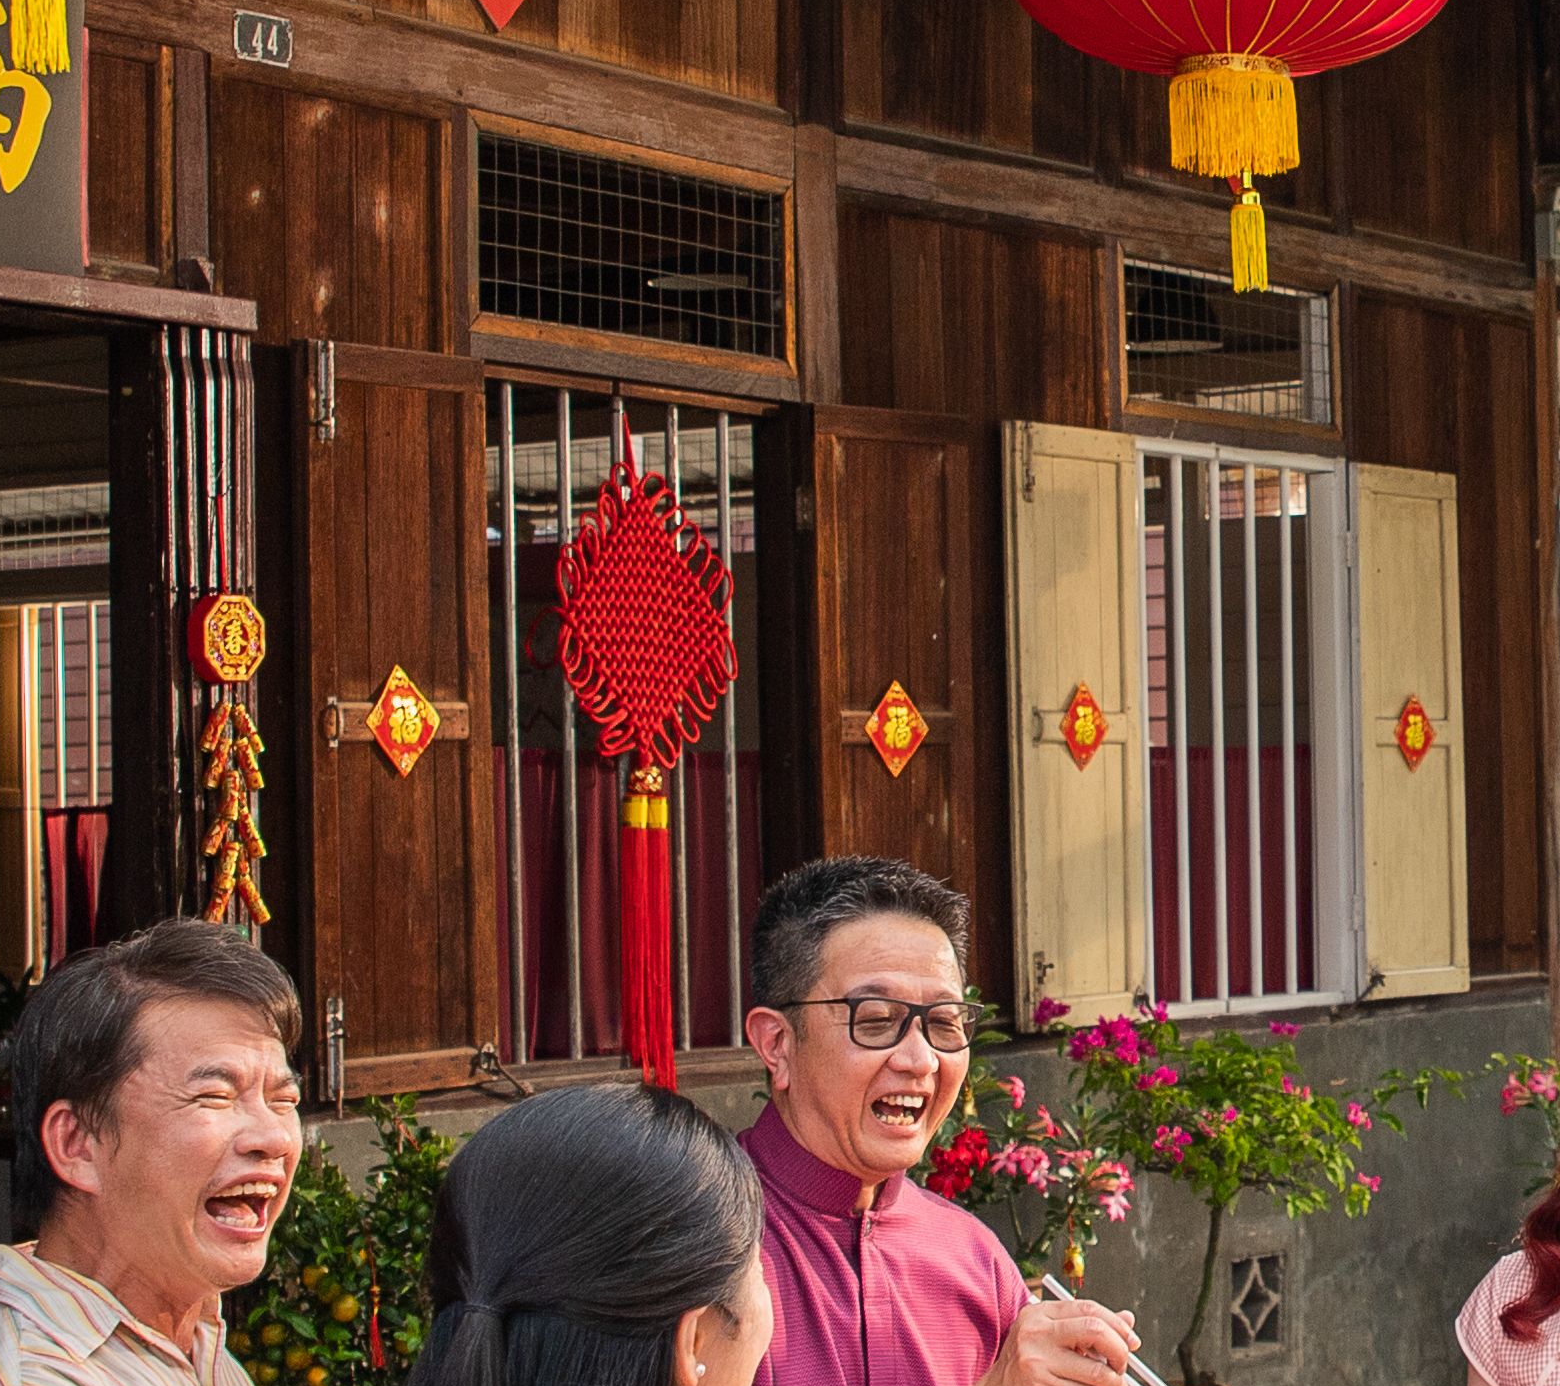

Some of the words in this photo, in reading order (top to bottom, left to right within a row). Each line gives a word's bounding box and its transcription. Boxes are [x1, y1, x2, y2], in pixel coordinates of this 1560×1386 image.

[252, 22, 278, 56] 44
[224, 619, 248, 654] 春
[389, 695, 423, 744] 福
[883, 706, 913, 749] 福
[1074, 705, 1097, 745] 福
[1406, 715, 1425, 750] 福
